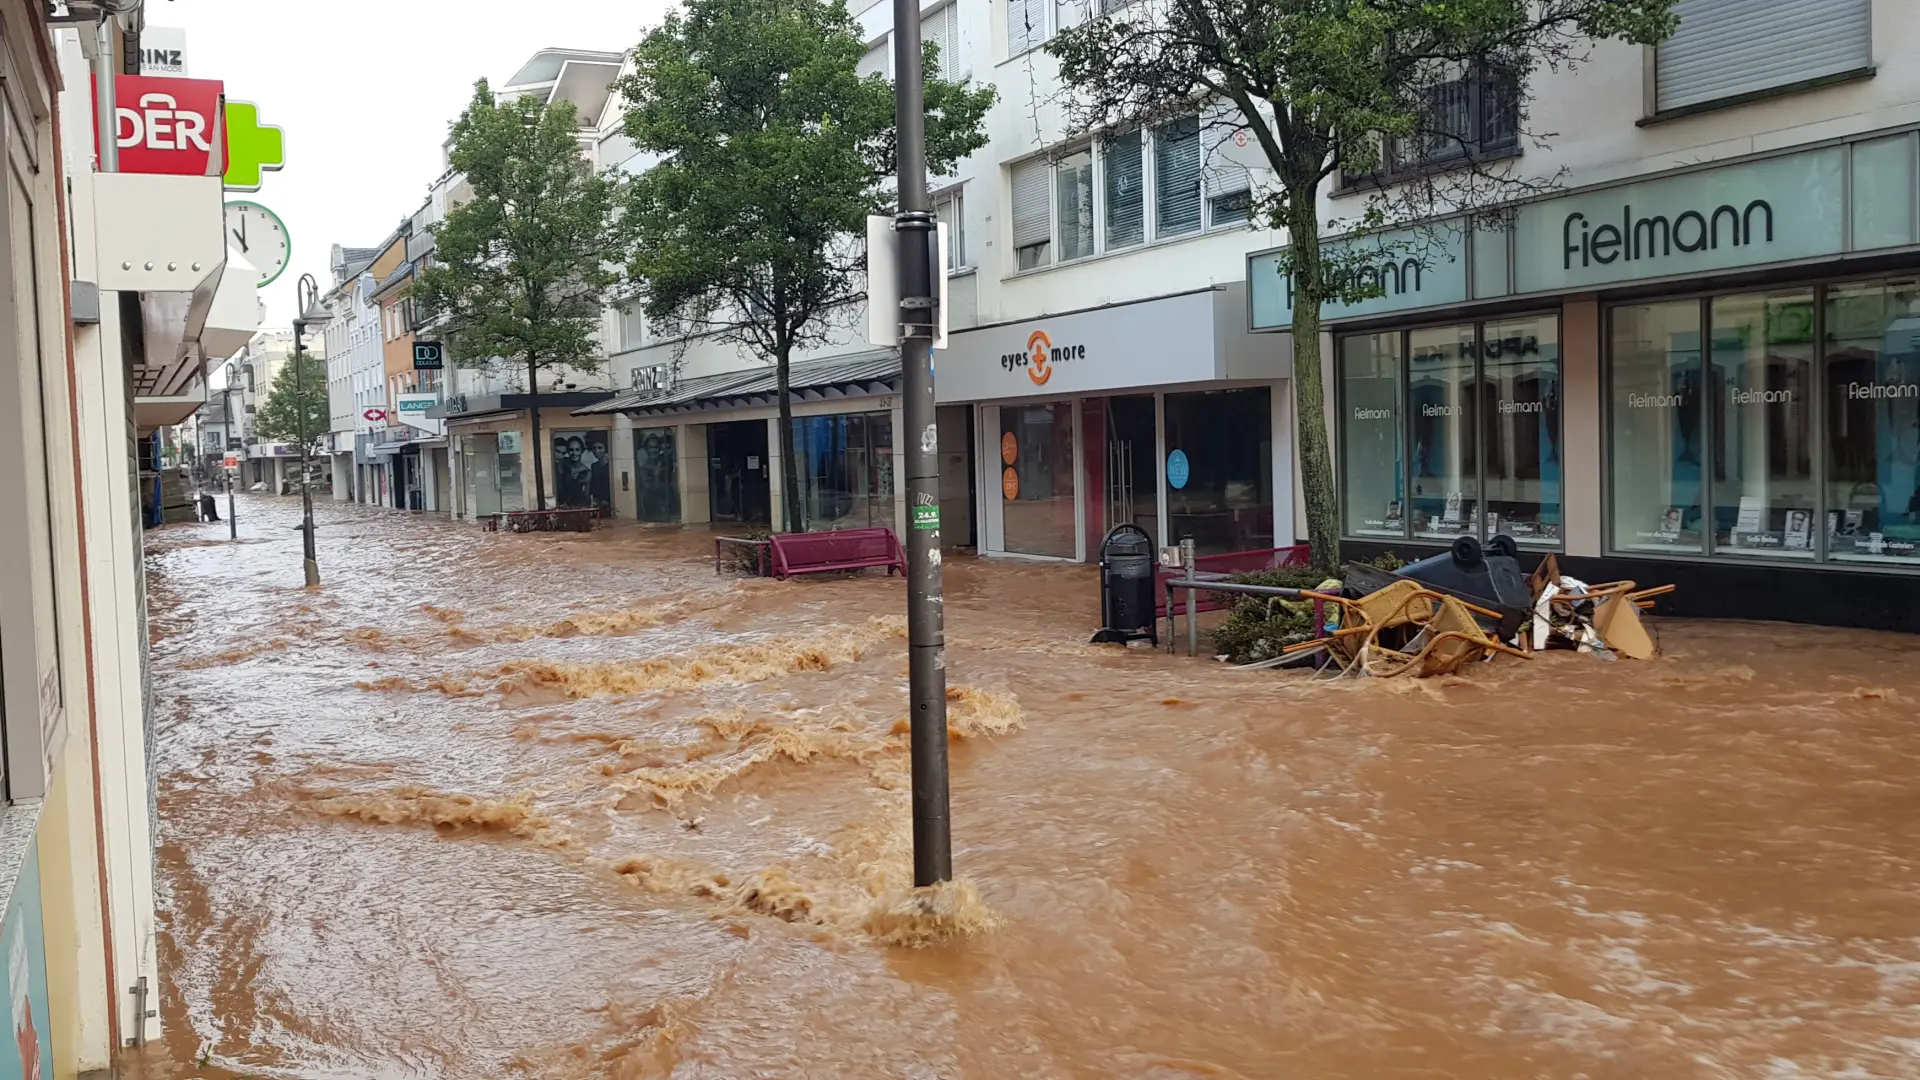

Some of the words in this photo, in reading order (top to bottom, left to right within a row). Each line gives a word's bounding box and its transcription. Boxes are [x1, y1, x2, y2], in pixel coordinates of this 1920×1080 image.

[116, 107, 211, 151] DER
[1563, 199, 1773, 269] fielmann
[1001, 352, 1028, 372] eyes
[1051, 344, 1085, 362] more
[1732, 388, 1792, 404] fielmann
[1849, 382, 1918, 400] fielmann
[1498, 400, 1543, 414] fielmann
[1628, 393, 1682, 408] fielmann
[1354, 407, 1390, 419] fielmann
[1422, 404, 1462, 417] fielmann
[918, 511, 938, 519] 24.9.
